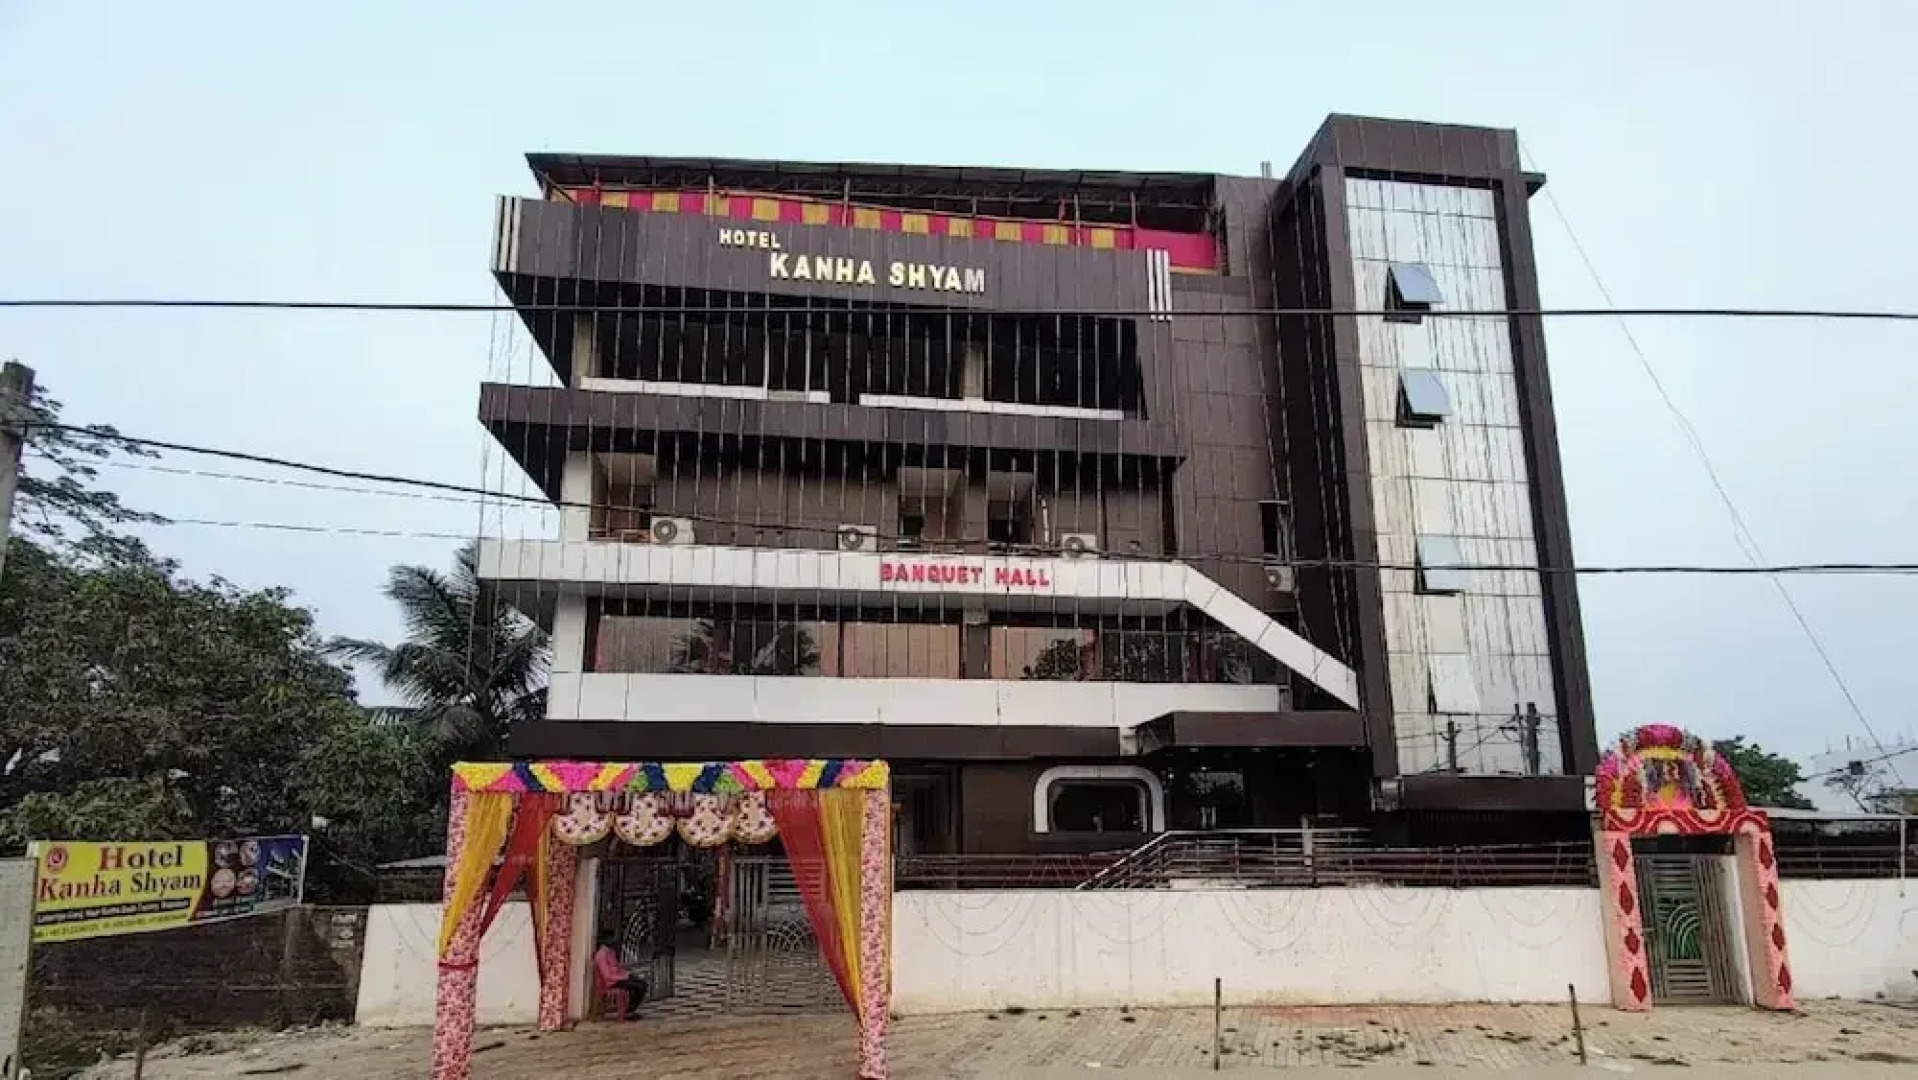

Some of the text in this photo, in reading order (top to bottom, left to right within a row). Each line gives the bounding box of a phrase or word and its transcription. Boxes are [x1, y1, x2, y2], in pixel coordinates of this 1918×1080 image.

[719, 229, 781, 249] HOTEL
[770, 252, 986, 293] KANHA SHYAM
[880, 563, 1050, 587] BANQUET HALL
[99, 845, 183, 870] Hotel
[39, 871, 202, 901] Kanha Shyam
